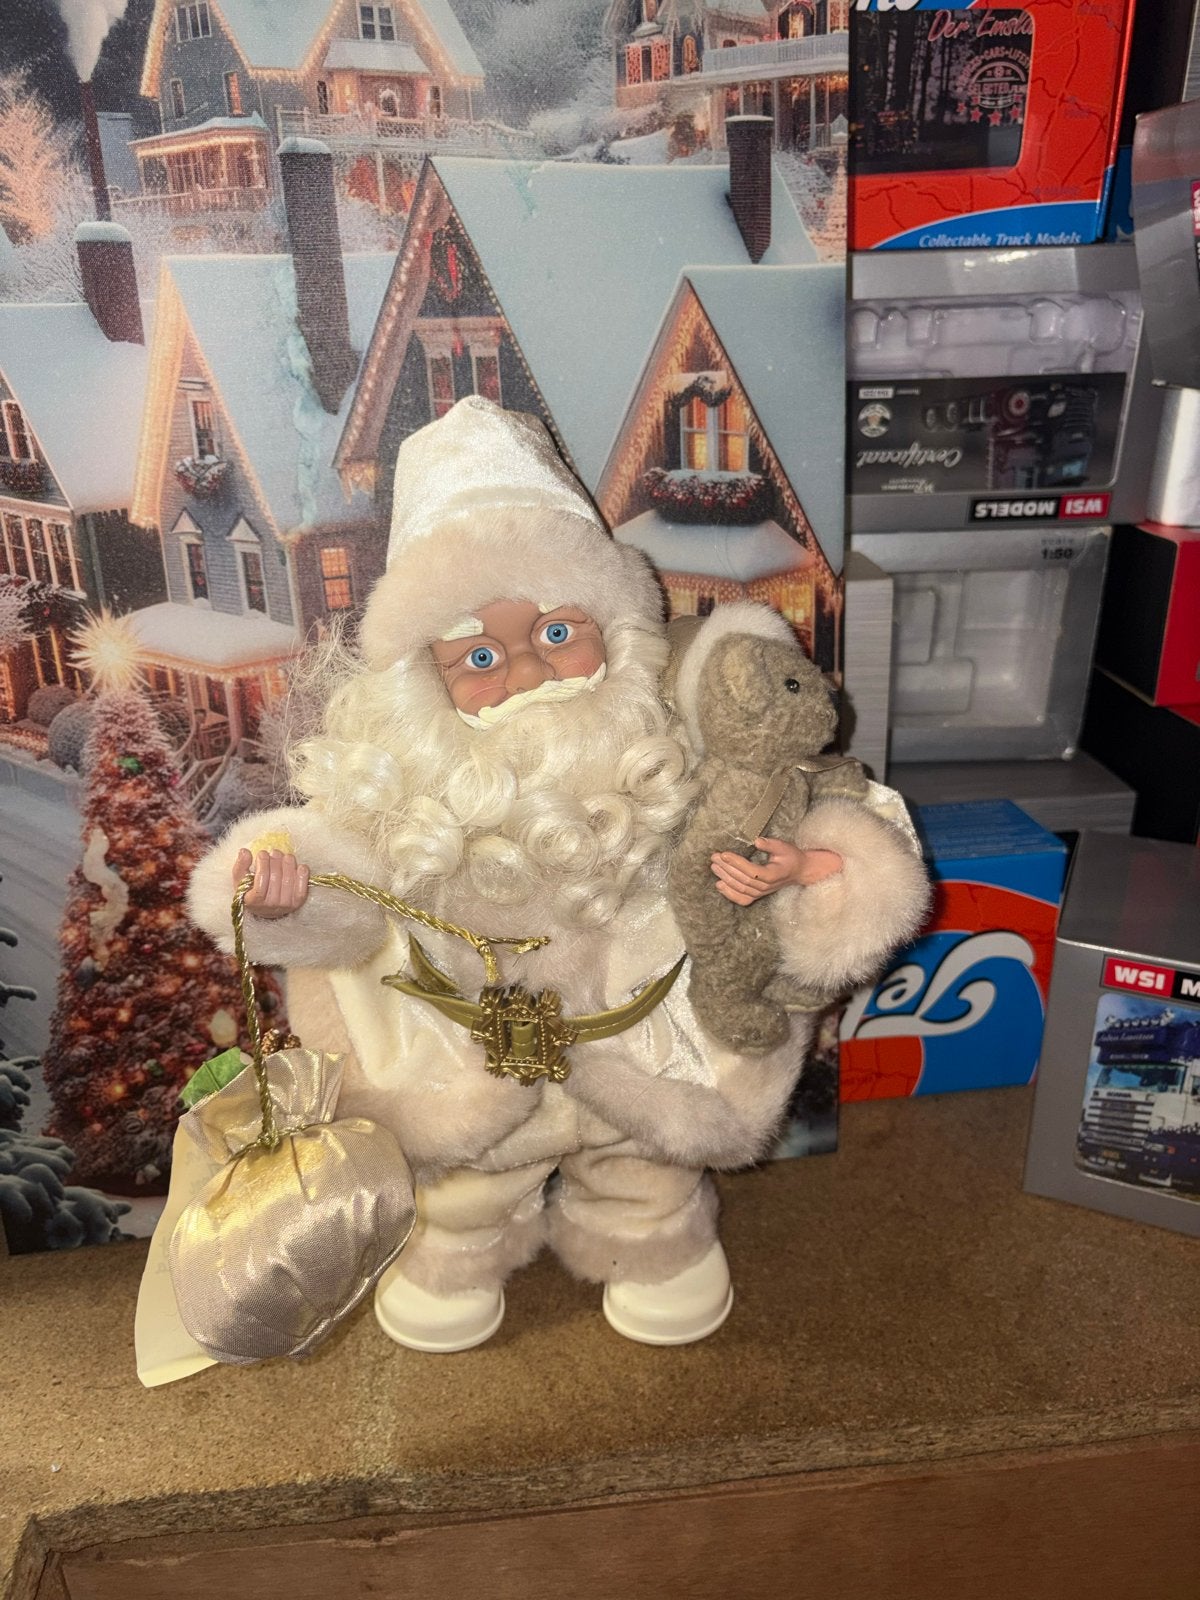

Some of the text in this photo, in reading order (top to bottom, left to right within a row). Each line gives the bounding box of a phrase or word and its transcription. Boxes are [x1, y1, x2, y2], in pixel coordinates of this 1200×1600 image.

[927, 10, 970, 42] Der
[918, 231, 1082, 249] Collectable Truck Models
[974, 496, 1104, 519] WSI MODELS
[1113, 964, 1166, 991] WSI
